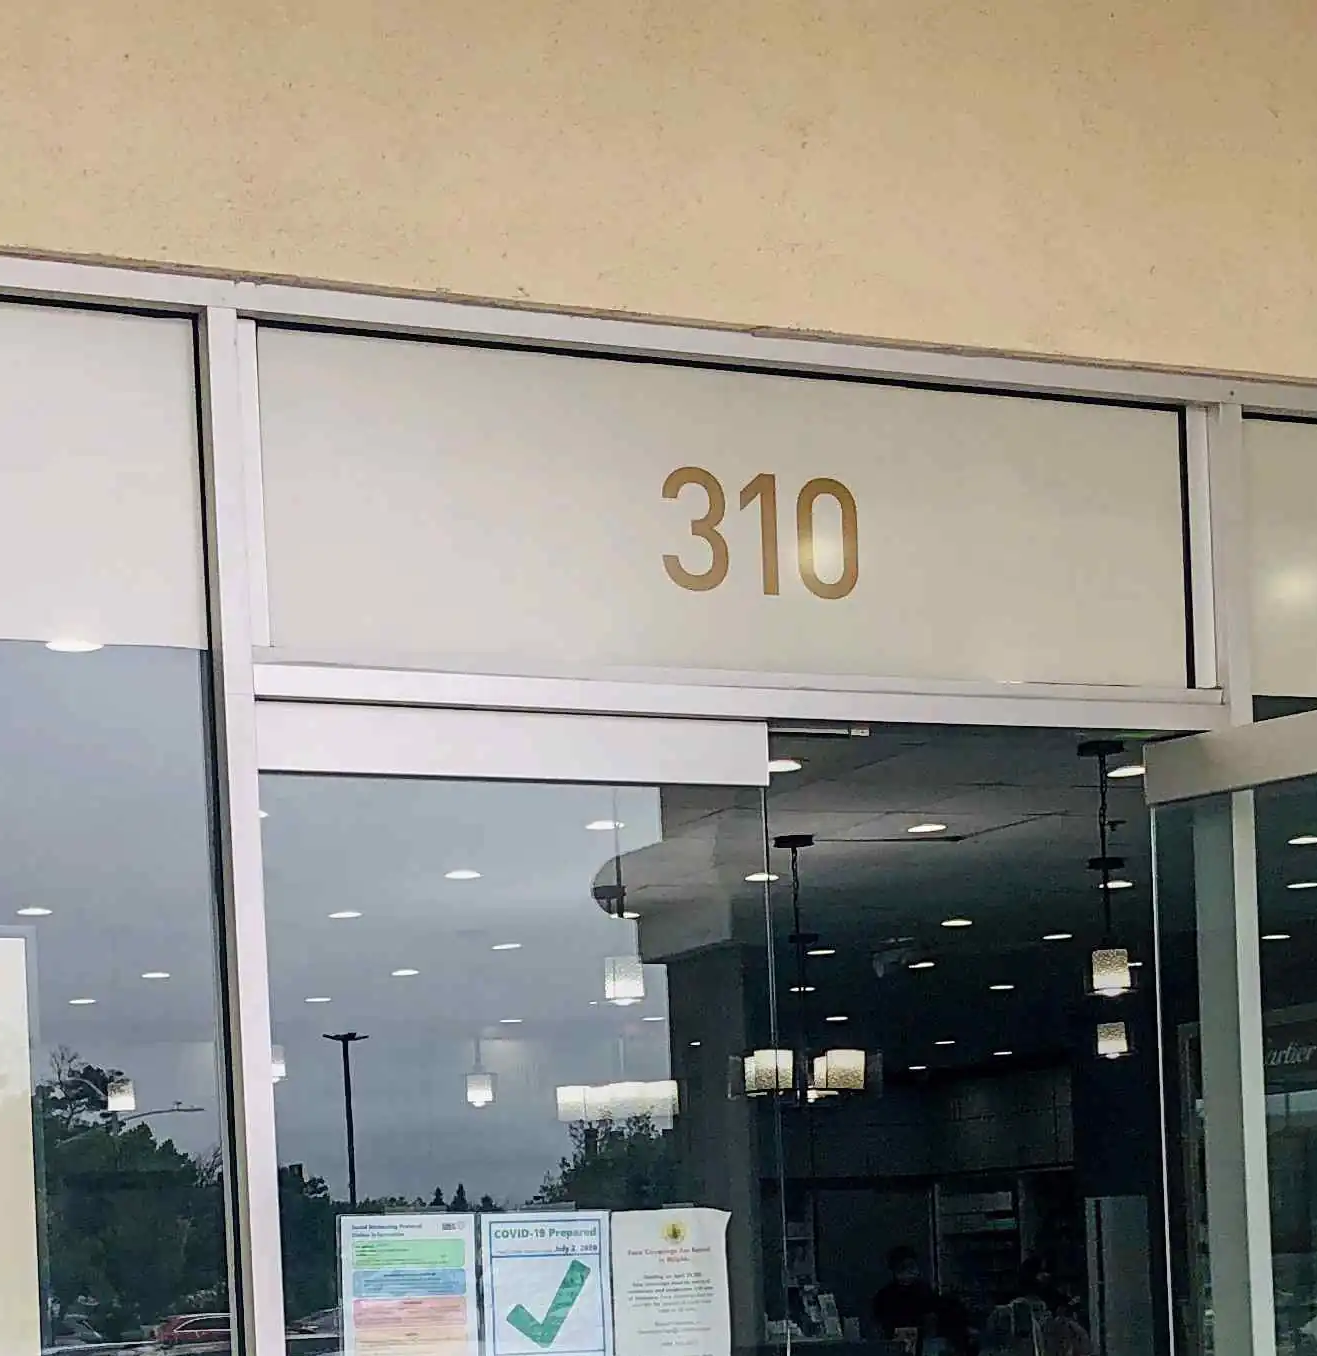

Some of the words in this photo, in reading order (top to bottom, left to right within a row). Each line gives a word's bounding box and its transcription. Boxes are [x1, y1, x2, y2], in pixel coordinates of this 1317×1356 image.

[661, 466, 858, 600] 310
[1264, 1038, 1317, 1066] artier
[494, 1228, 546, 1239] COVID-19
[549, 1226, 596, 1240] Prepared
